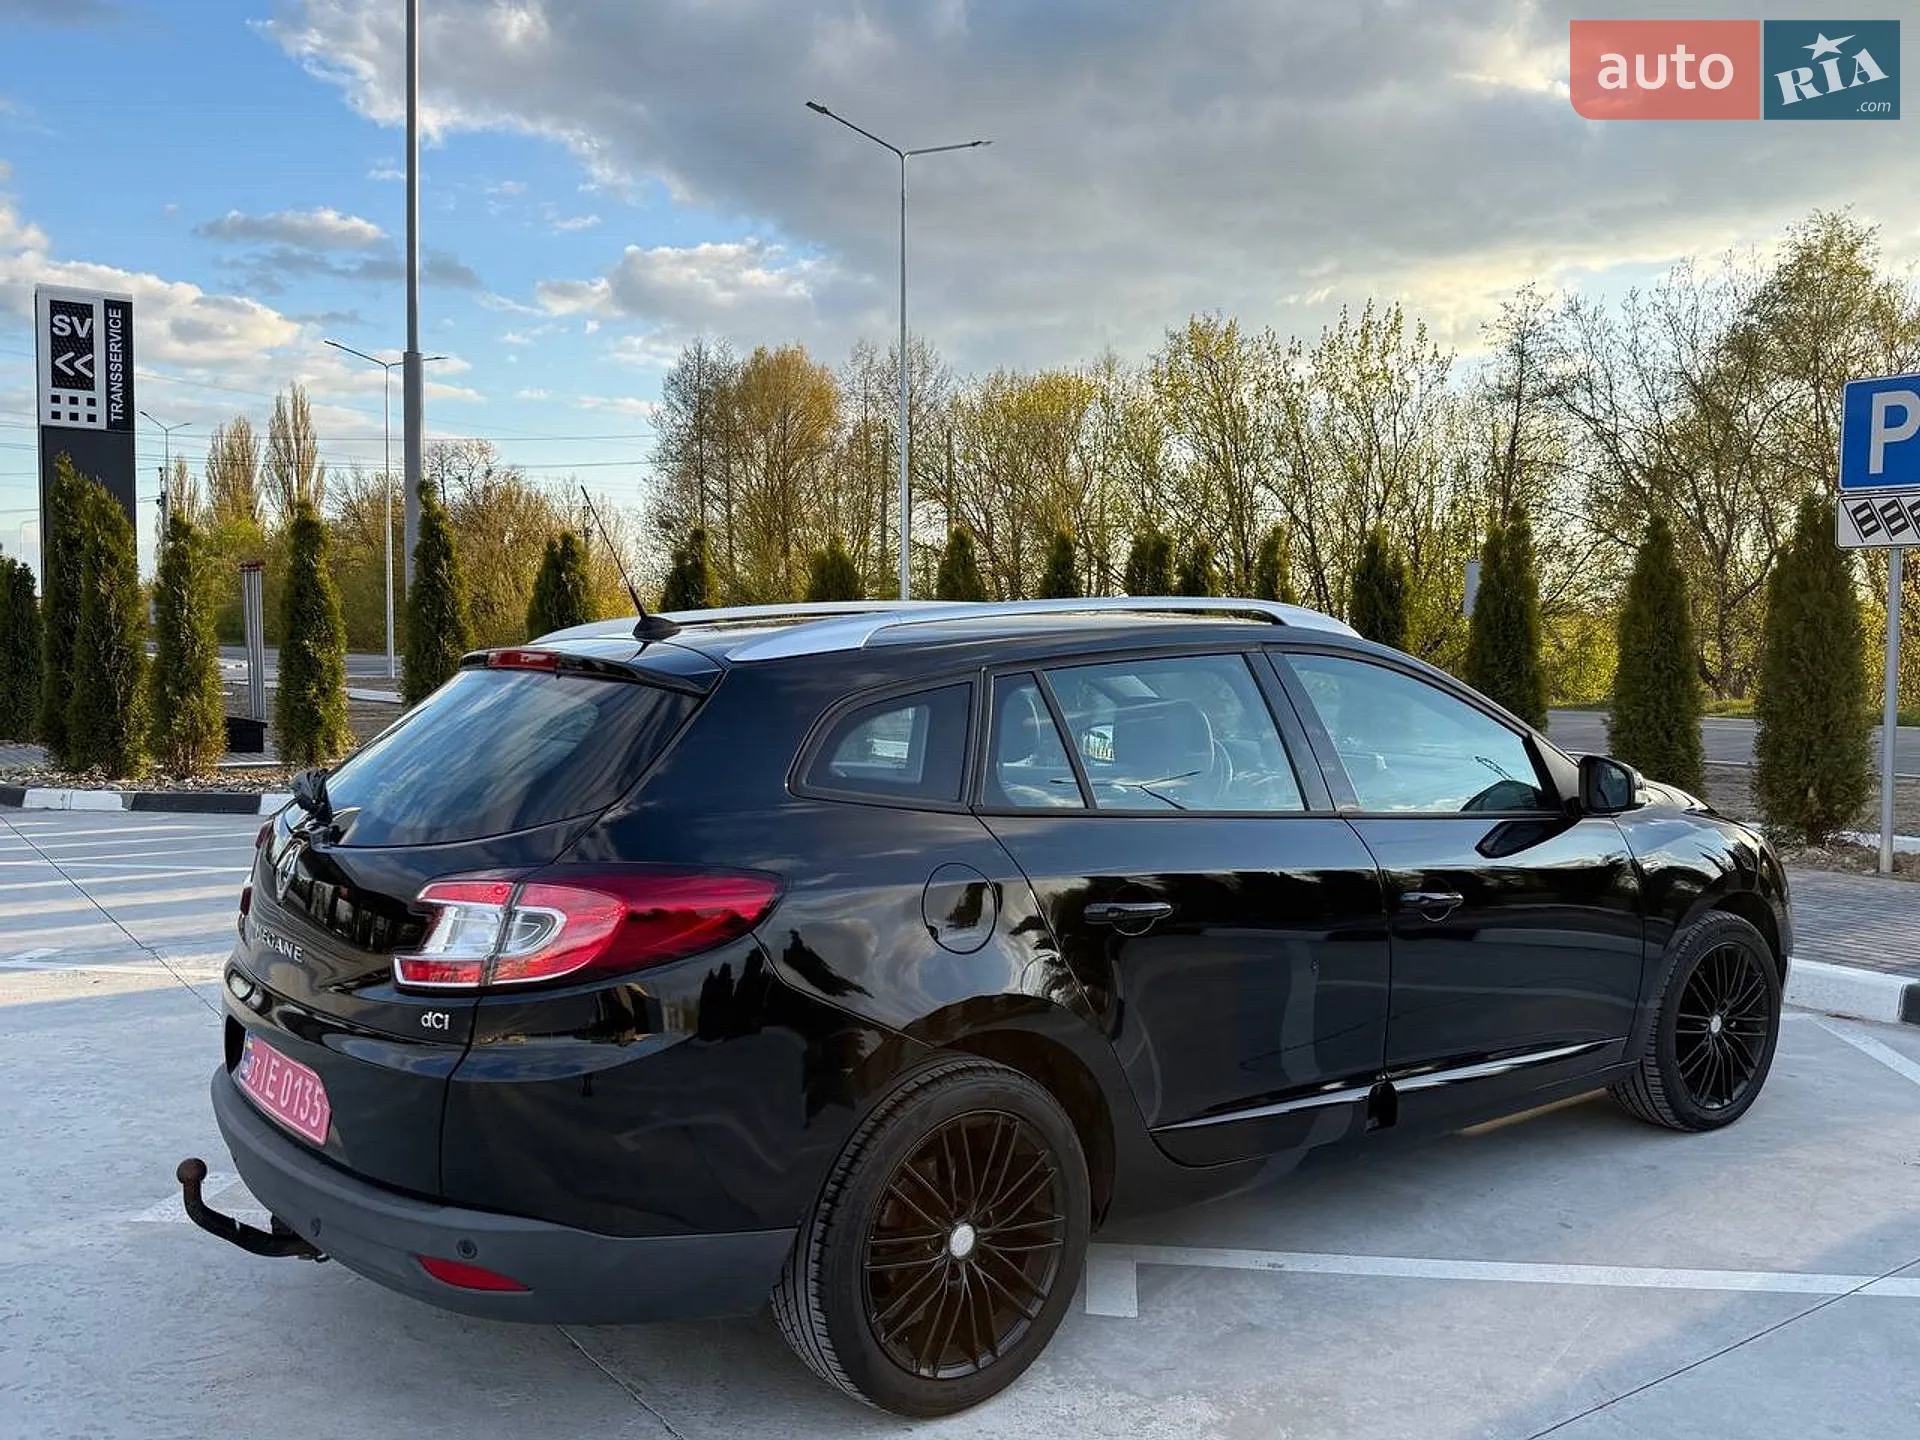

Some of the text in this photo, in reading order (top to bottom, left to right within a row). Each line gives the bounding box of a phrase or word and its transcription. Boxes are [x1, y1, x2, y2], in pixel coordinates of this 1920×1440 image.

[52, 314, 93, 338] SV
[108, 308, 124, 422] TRANSSERVICE
[1869, 390, 1920, 475] P
